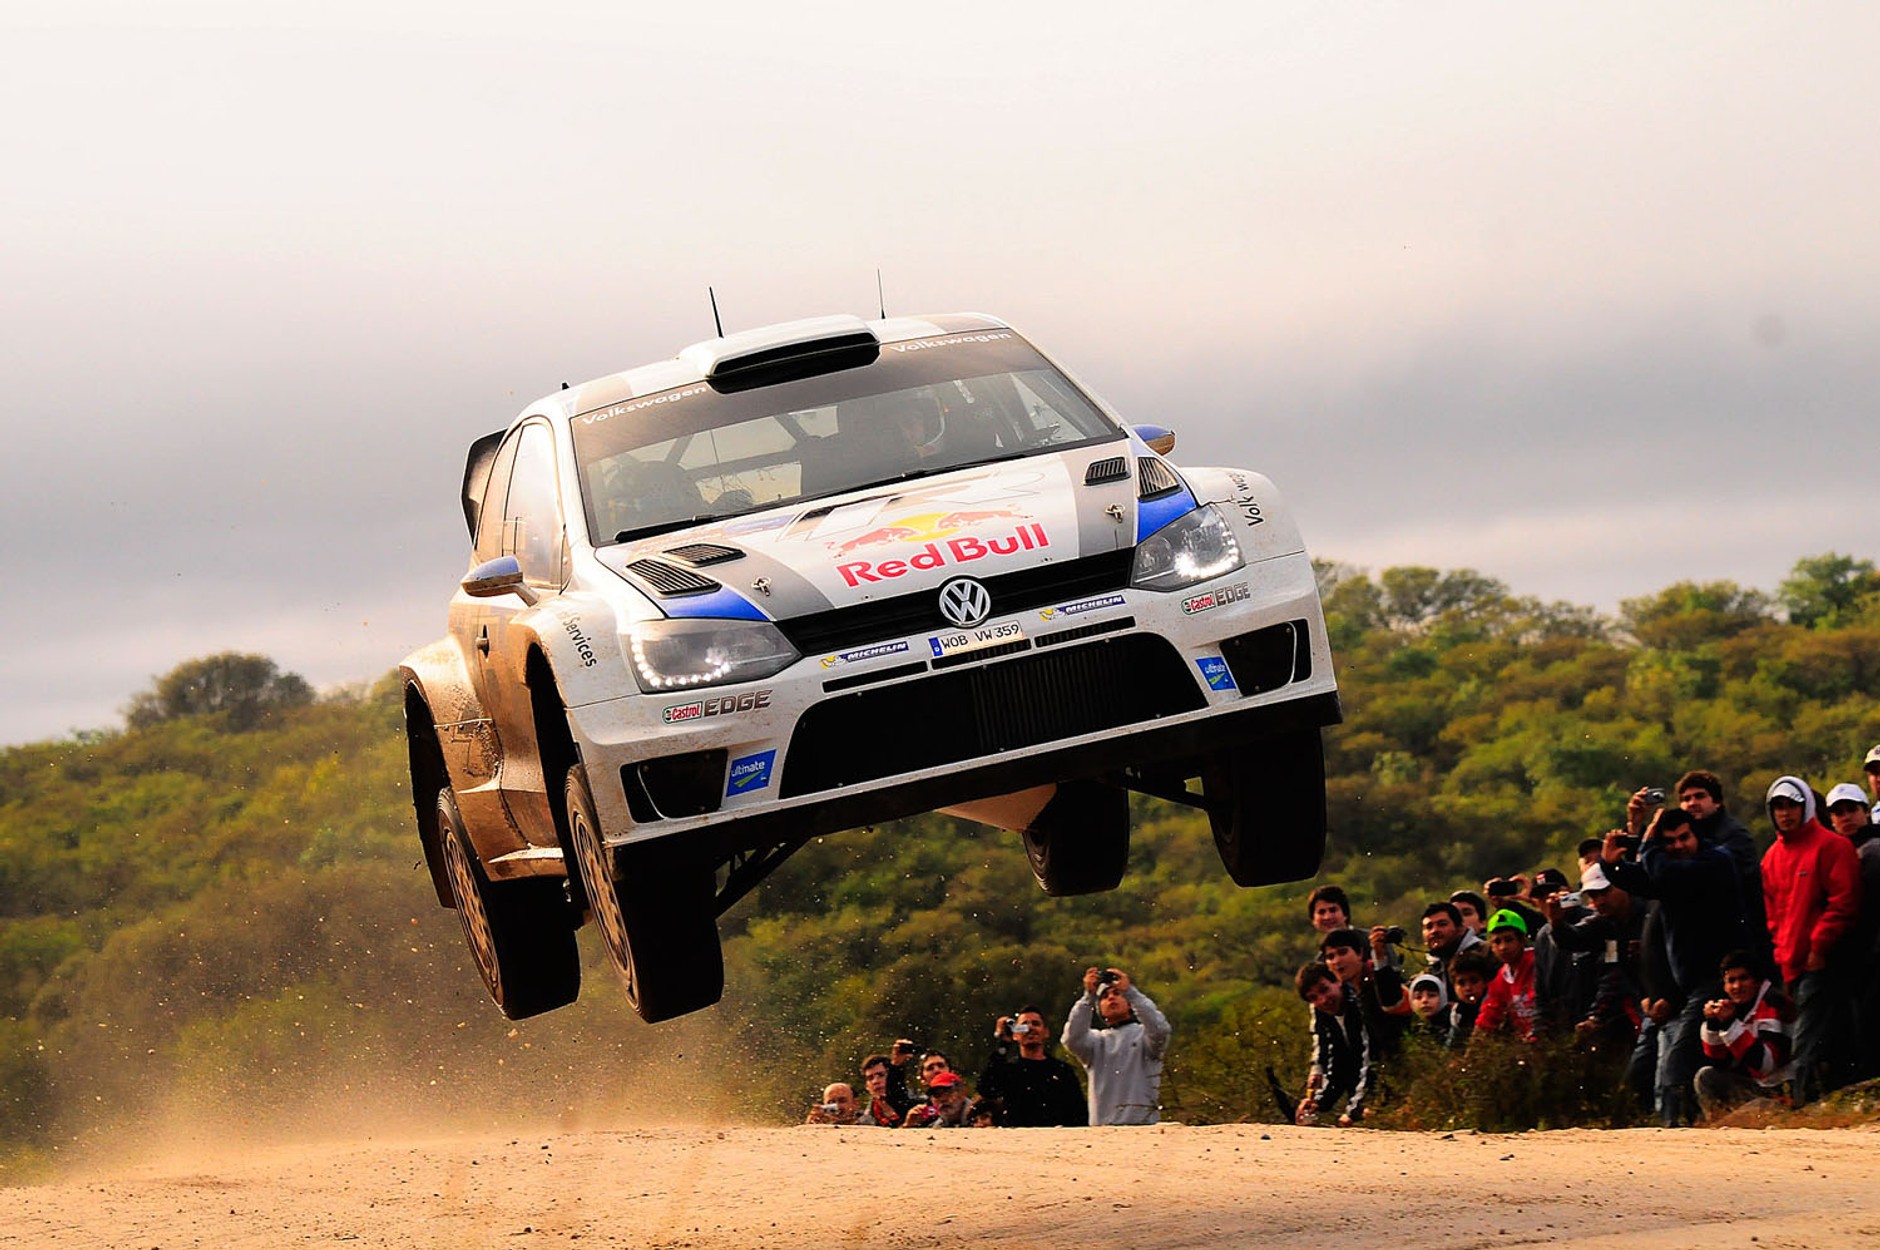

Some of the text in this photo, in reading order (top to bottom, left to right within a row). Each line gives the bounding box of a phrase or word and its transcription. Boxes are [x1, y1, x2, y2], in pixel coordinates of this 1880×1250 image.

[889, 332, 1012, 353] Volkswagen
[581, 386, 707, 425] Volkswagen
[836, 523, 1050, 587] Red Bull
[1065, 595, 1123, 613] MICHELIN
[1215, 582, 1251, 607] EDGE
[563, 617, 598, 667] Services
[940, 634, 969, 650] WOB
[975, 629, 993, 643] VW
[995, 624, 1019, 639] 359
[847, 643, 907, 660] MICHELIN
[671, 690, 773, 720] Castrol EDGE
